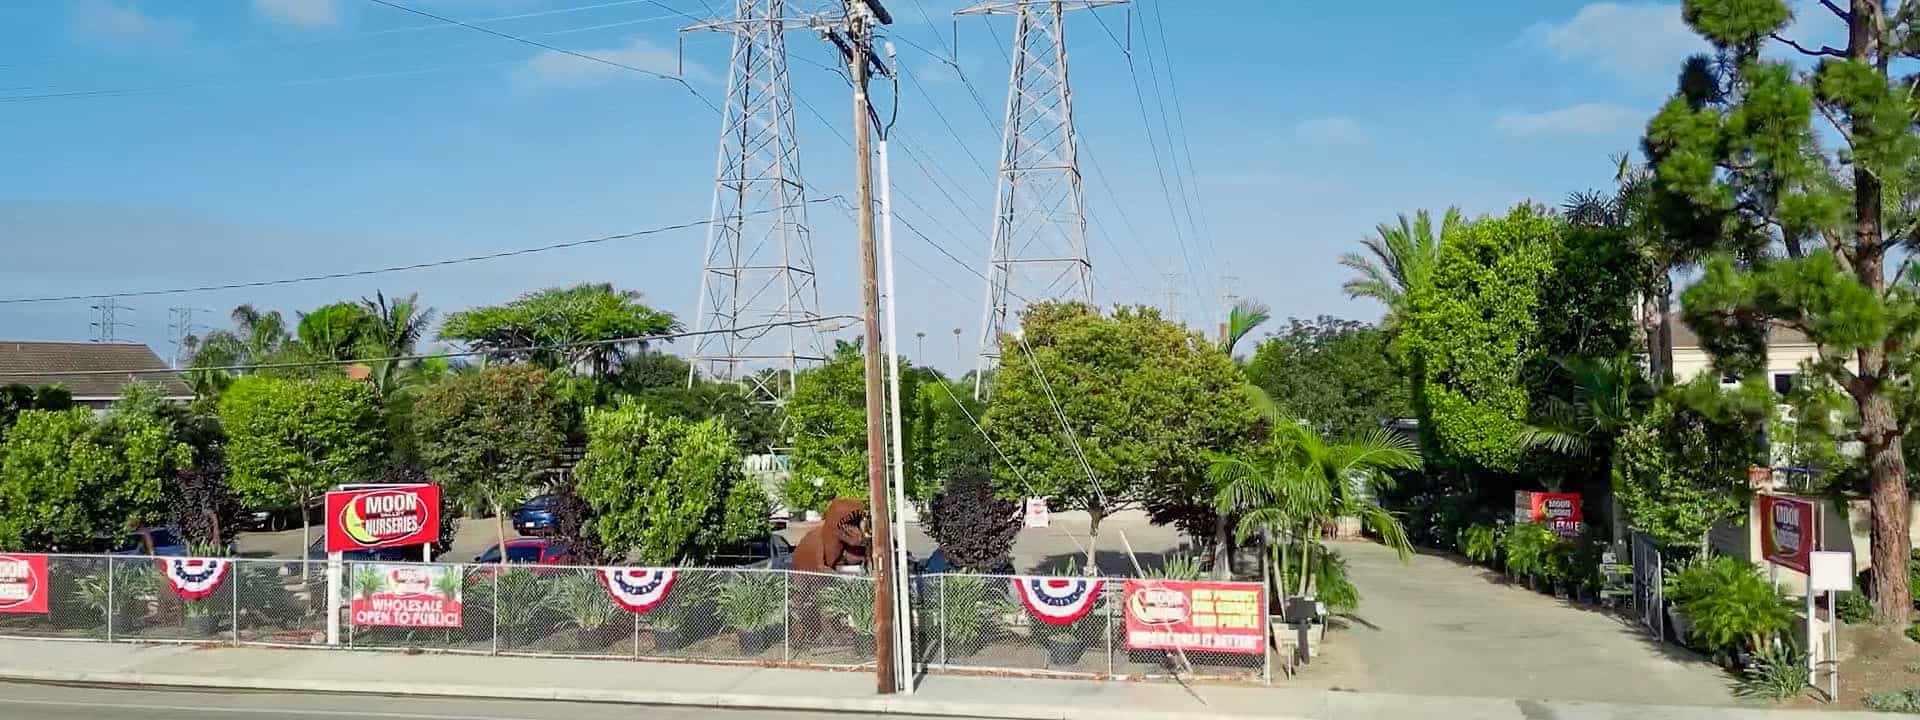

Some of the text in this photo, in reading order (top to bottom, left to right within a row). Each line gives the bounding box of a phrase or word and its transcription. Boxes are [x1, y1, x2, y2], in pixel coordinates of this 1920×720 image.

[365, 493, 417, 514] MOON
[365, 515, 418, 536] NURSERIES
[372, 599, 443, 613] WHOLESALE
[356, 611, 459, 626] OPEN TO PUBLIC!
